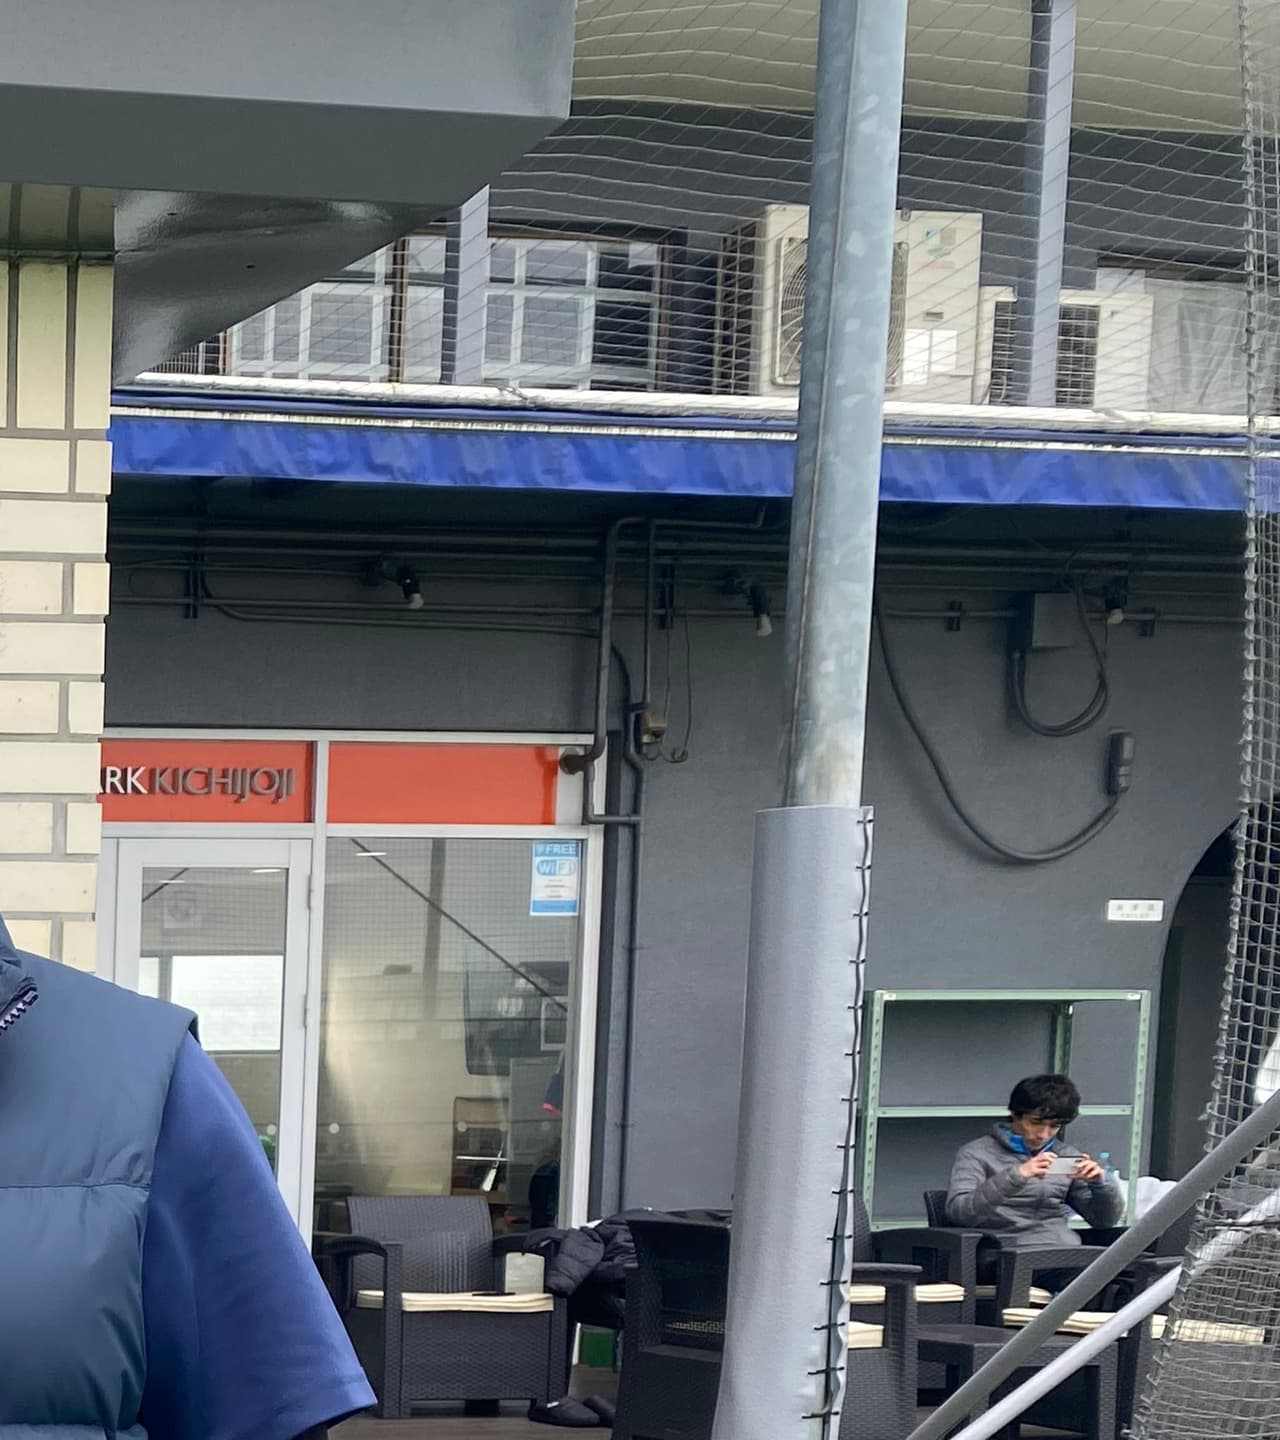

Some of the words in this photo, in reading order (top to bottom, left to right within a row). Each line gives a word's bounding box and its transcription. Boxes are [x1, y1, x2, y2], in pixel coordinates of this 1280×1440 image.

[99, 766, 148, 794] RK
[151, 766, 297, 803] KICHIJOJI
[546, 844, 576, 854] FREE
